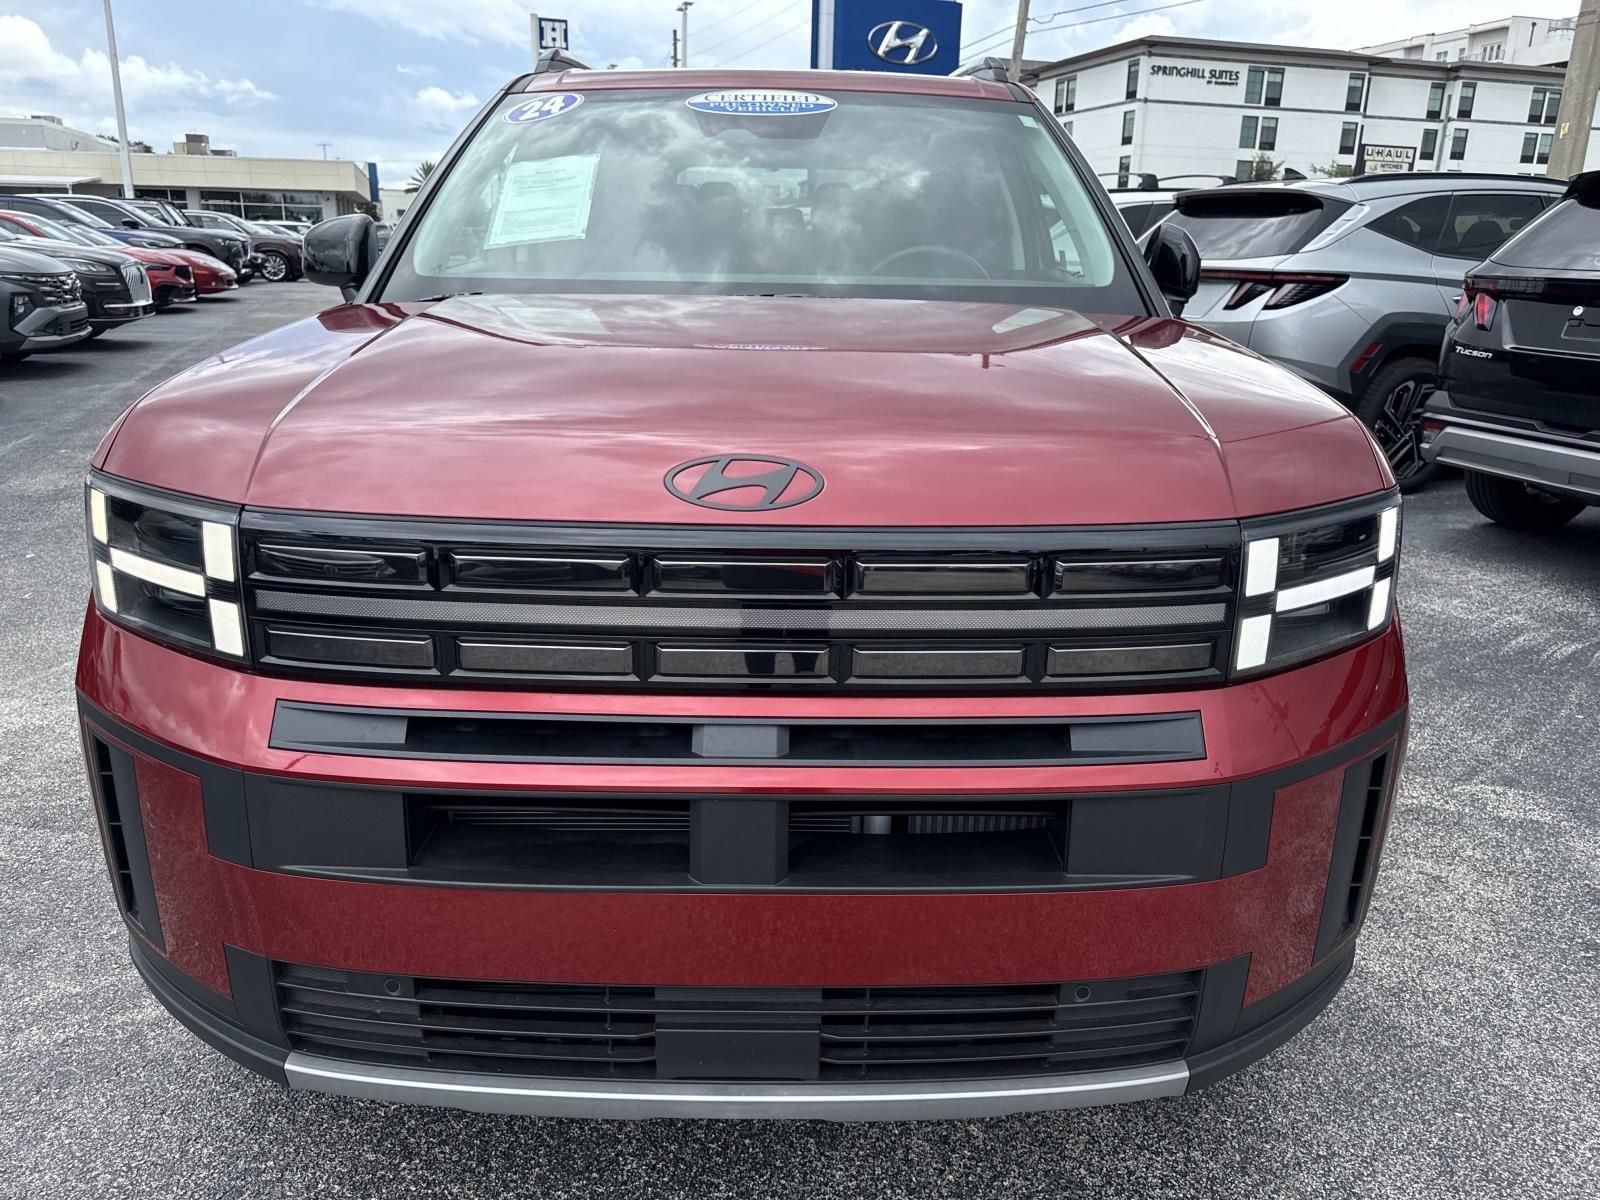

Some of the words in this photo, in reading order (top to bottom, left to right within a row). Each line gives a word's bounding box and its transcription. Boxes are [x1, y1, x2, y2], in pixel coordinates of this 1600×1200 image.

[1150, 64, 1206, 79] SPRINGHILL
[1208, 68, 1240, 81] SUITES
[704, 94, 820, 103] CERTIFIED
[518, 95, 566, 121] 24
[725, 105, 800, 113] VEHICLE
